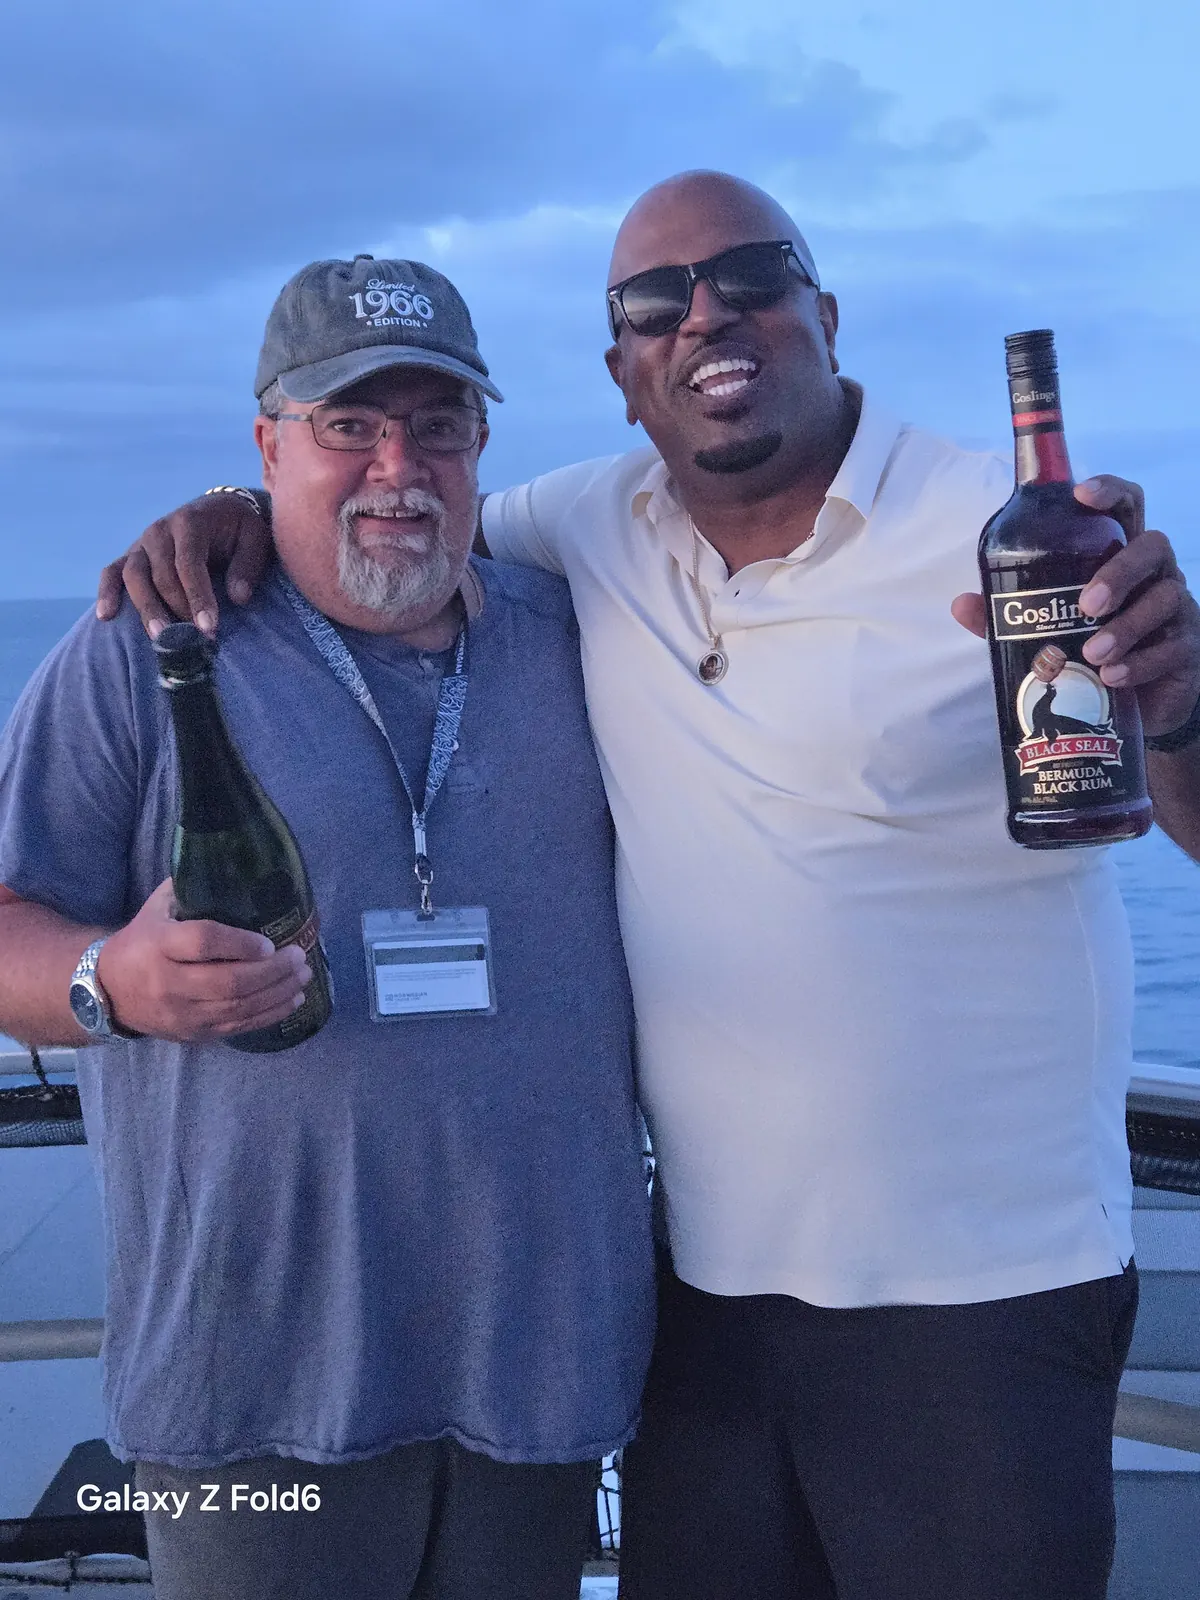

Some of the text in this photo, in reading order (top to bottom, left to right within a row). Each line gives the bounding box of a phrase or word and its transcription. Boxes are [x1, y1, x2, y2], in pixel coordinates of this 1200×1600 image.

[348, 290, 435, 320] 1966
[374, 317, 421, 327] EDITION
[1012, 390, 1056, 404] Goslings
[1025, 740, 1111, 759] BLACK SEAL
[1037, 766, 1105, 782] BERMUDA
[1032, 776, 1113, 795] BLACK RUM
